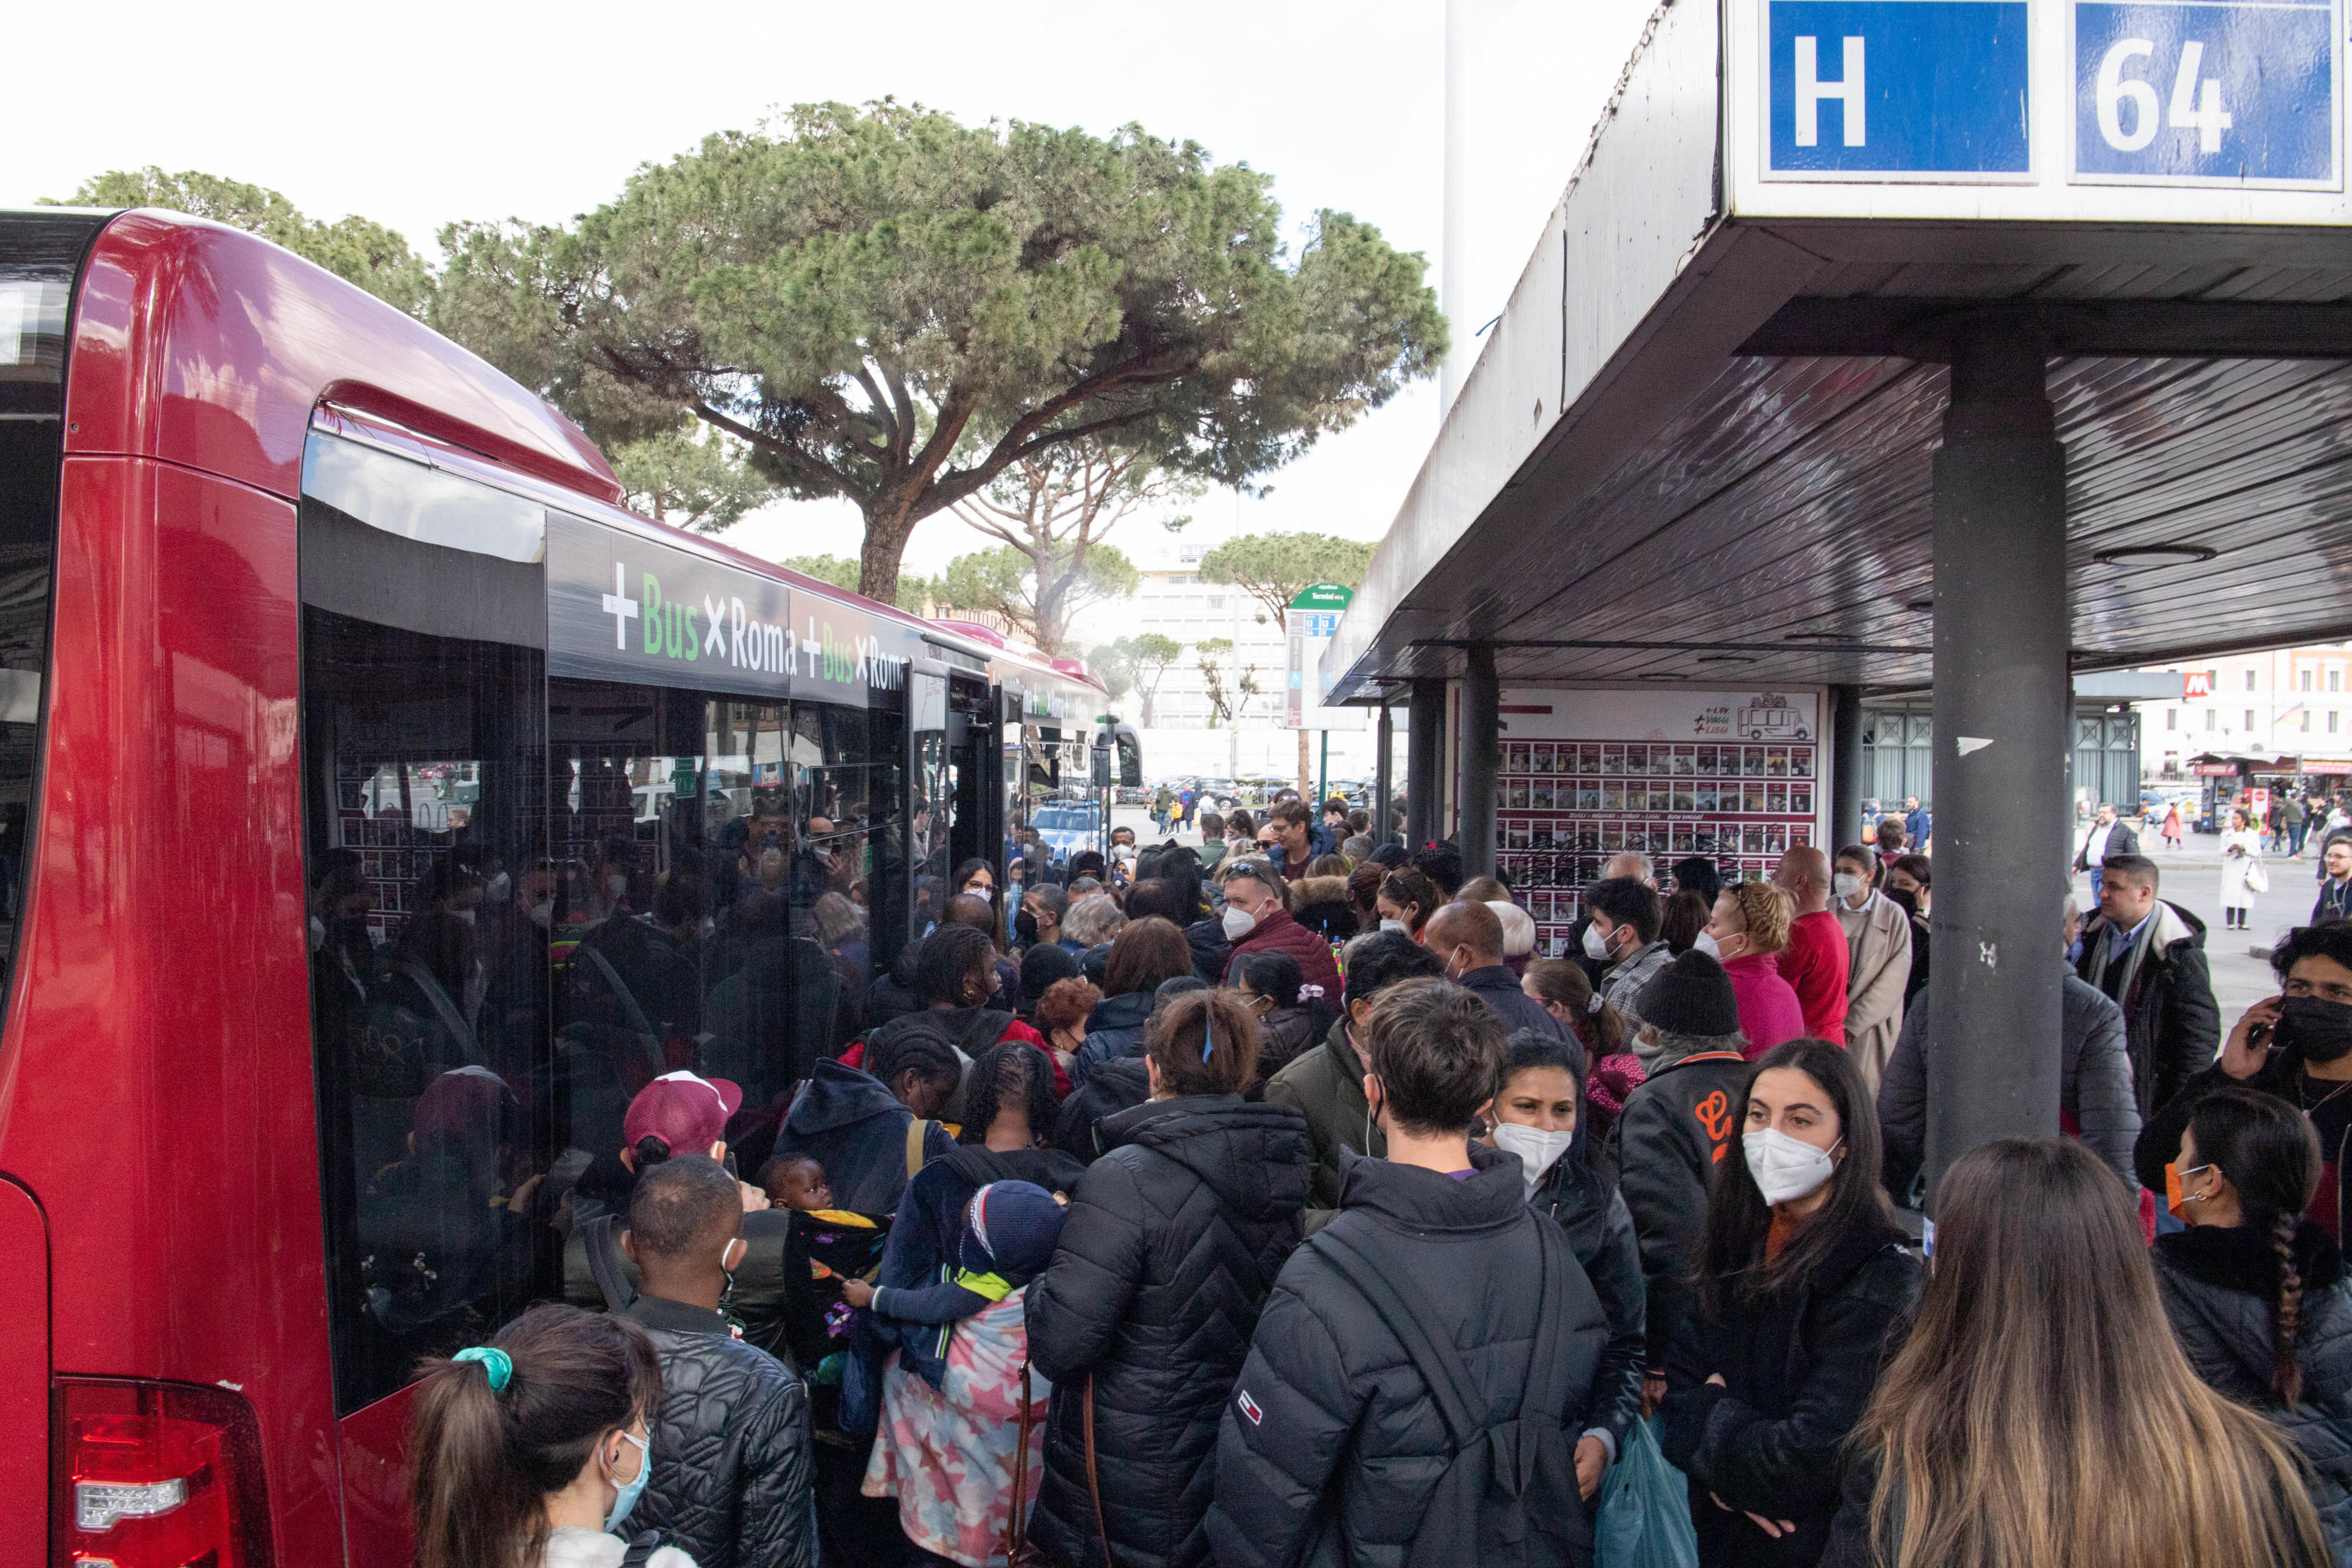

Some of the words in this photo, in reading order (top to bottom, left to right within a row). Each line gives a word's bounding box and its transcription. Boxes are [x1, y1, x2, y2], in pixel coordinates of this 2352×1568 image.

[1795, 36, 1865, 146] H
[2096, 38, 2231, 152] 64
[731, 596, 797, 675] Roma
[1306, 619, 1313, 628] U
[1322, 619, 1329, 628] U
[2187, 675, 2210, 693] M
